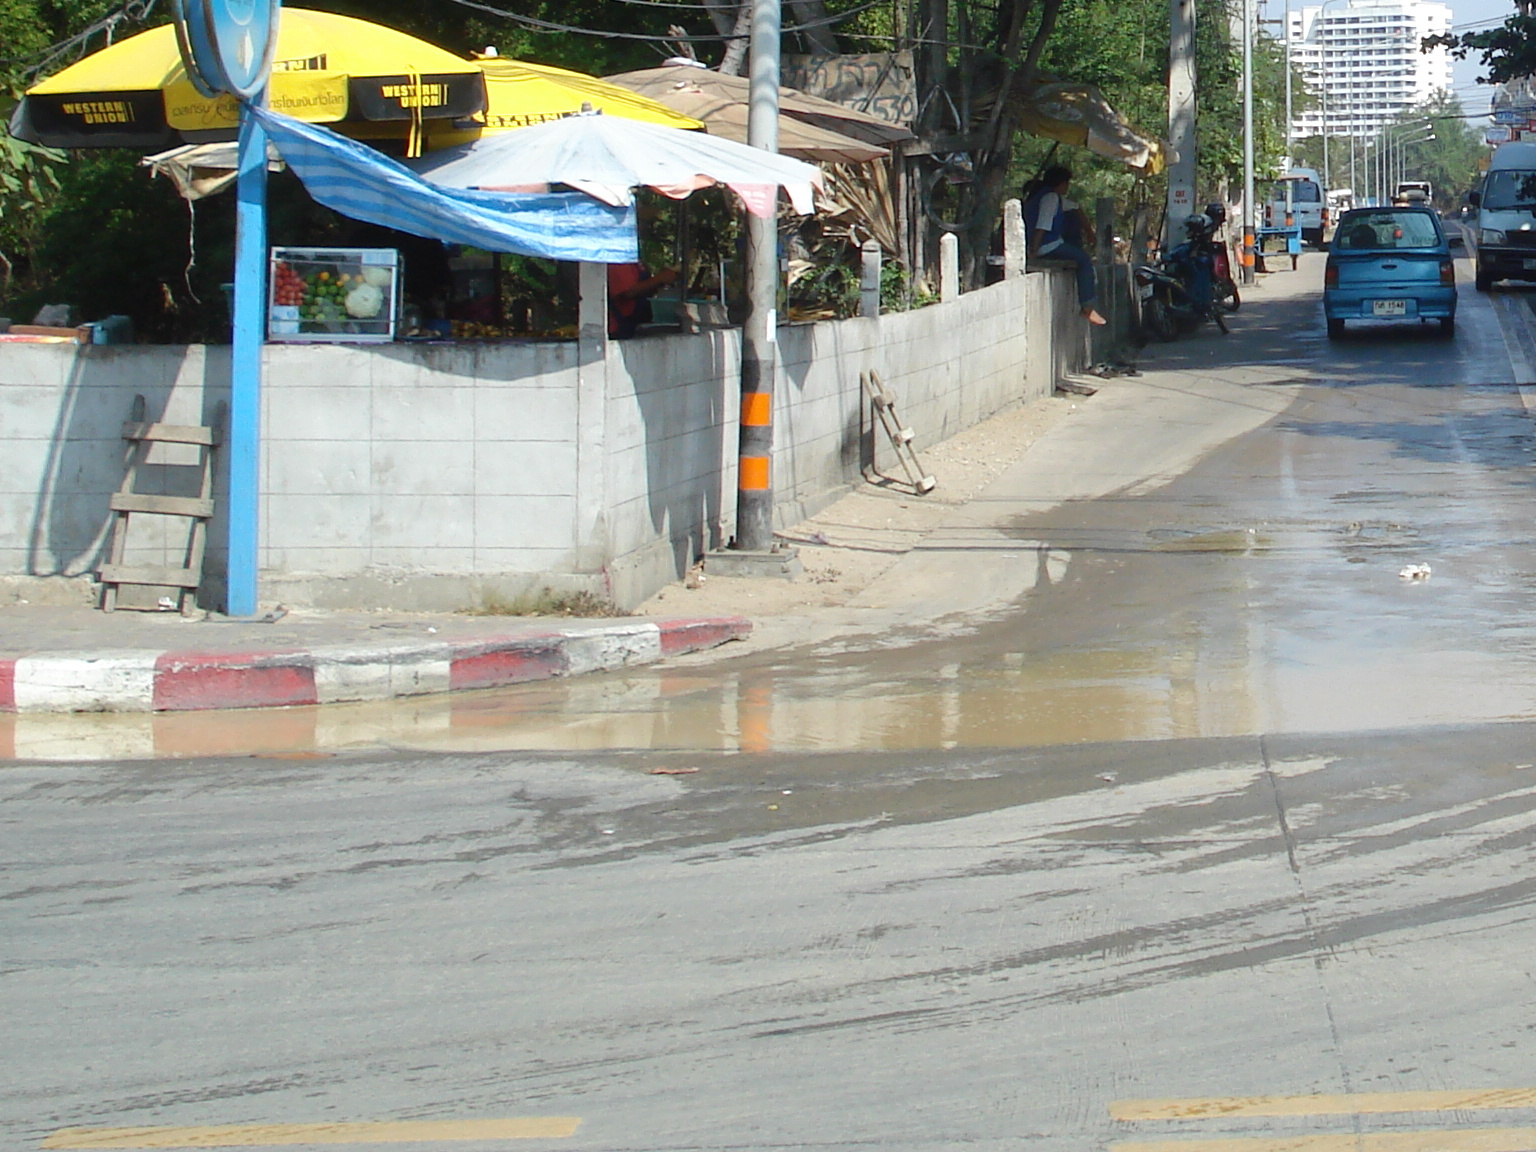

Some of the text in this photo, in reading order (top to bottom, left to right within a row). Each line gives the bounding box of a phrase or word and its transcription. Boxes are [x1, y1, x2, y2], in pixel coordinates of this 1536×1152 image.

[382, 84, 438, 97] WESTRN
[401, 95, 438, 108] UNON
[62, 102, 123, 114] WESTERN
[85, 112, 126, 124] UNION
